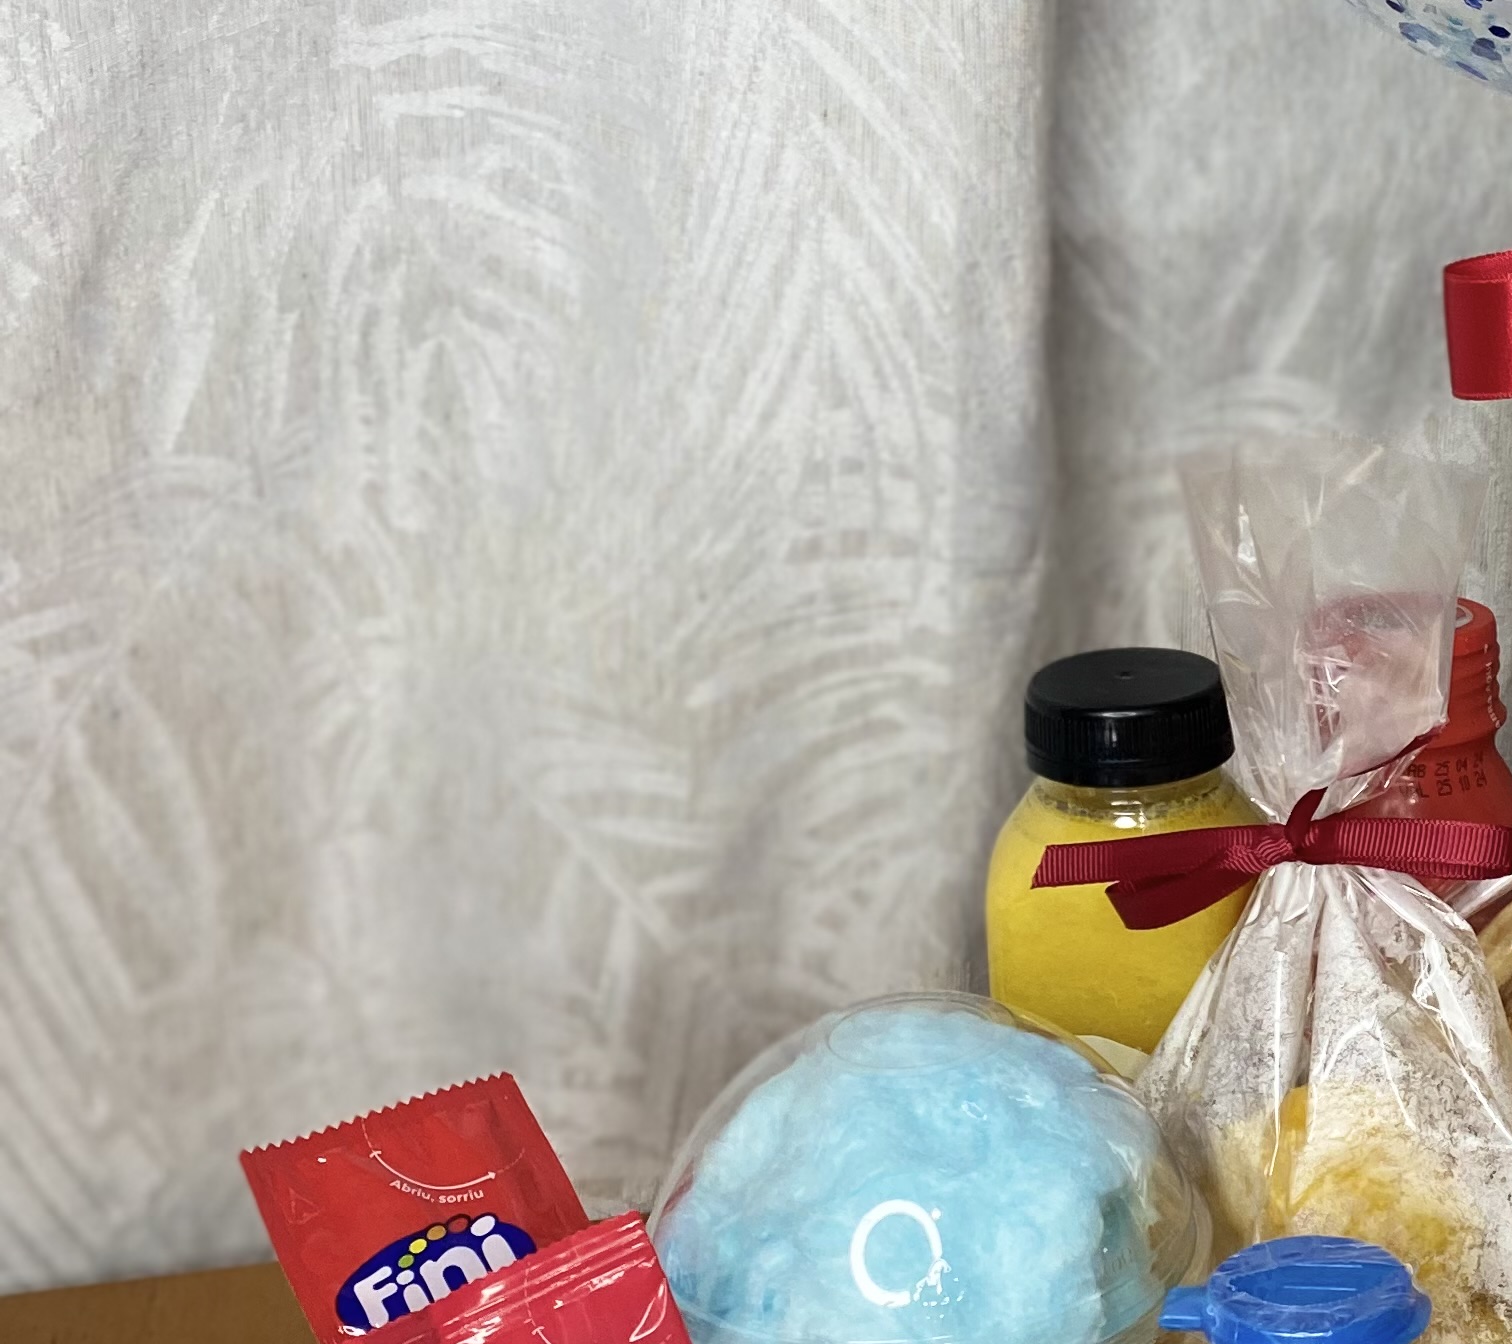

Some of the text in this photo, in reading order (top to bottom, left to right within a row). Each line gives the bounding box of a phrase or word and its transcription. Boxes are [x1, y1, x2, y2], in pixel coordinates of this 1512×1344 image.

[390, 1177, 485, 1204] Abriu, sorriu
[354, 1214, 520, 1328] Fini
